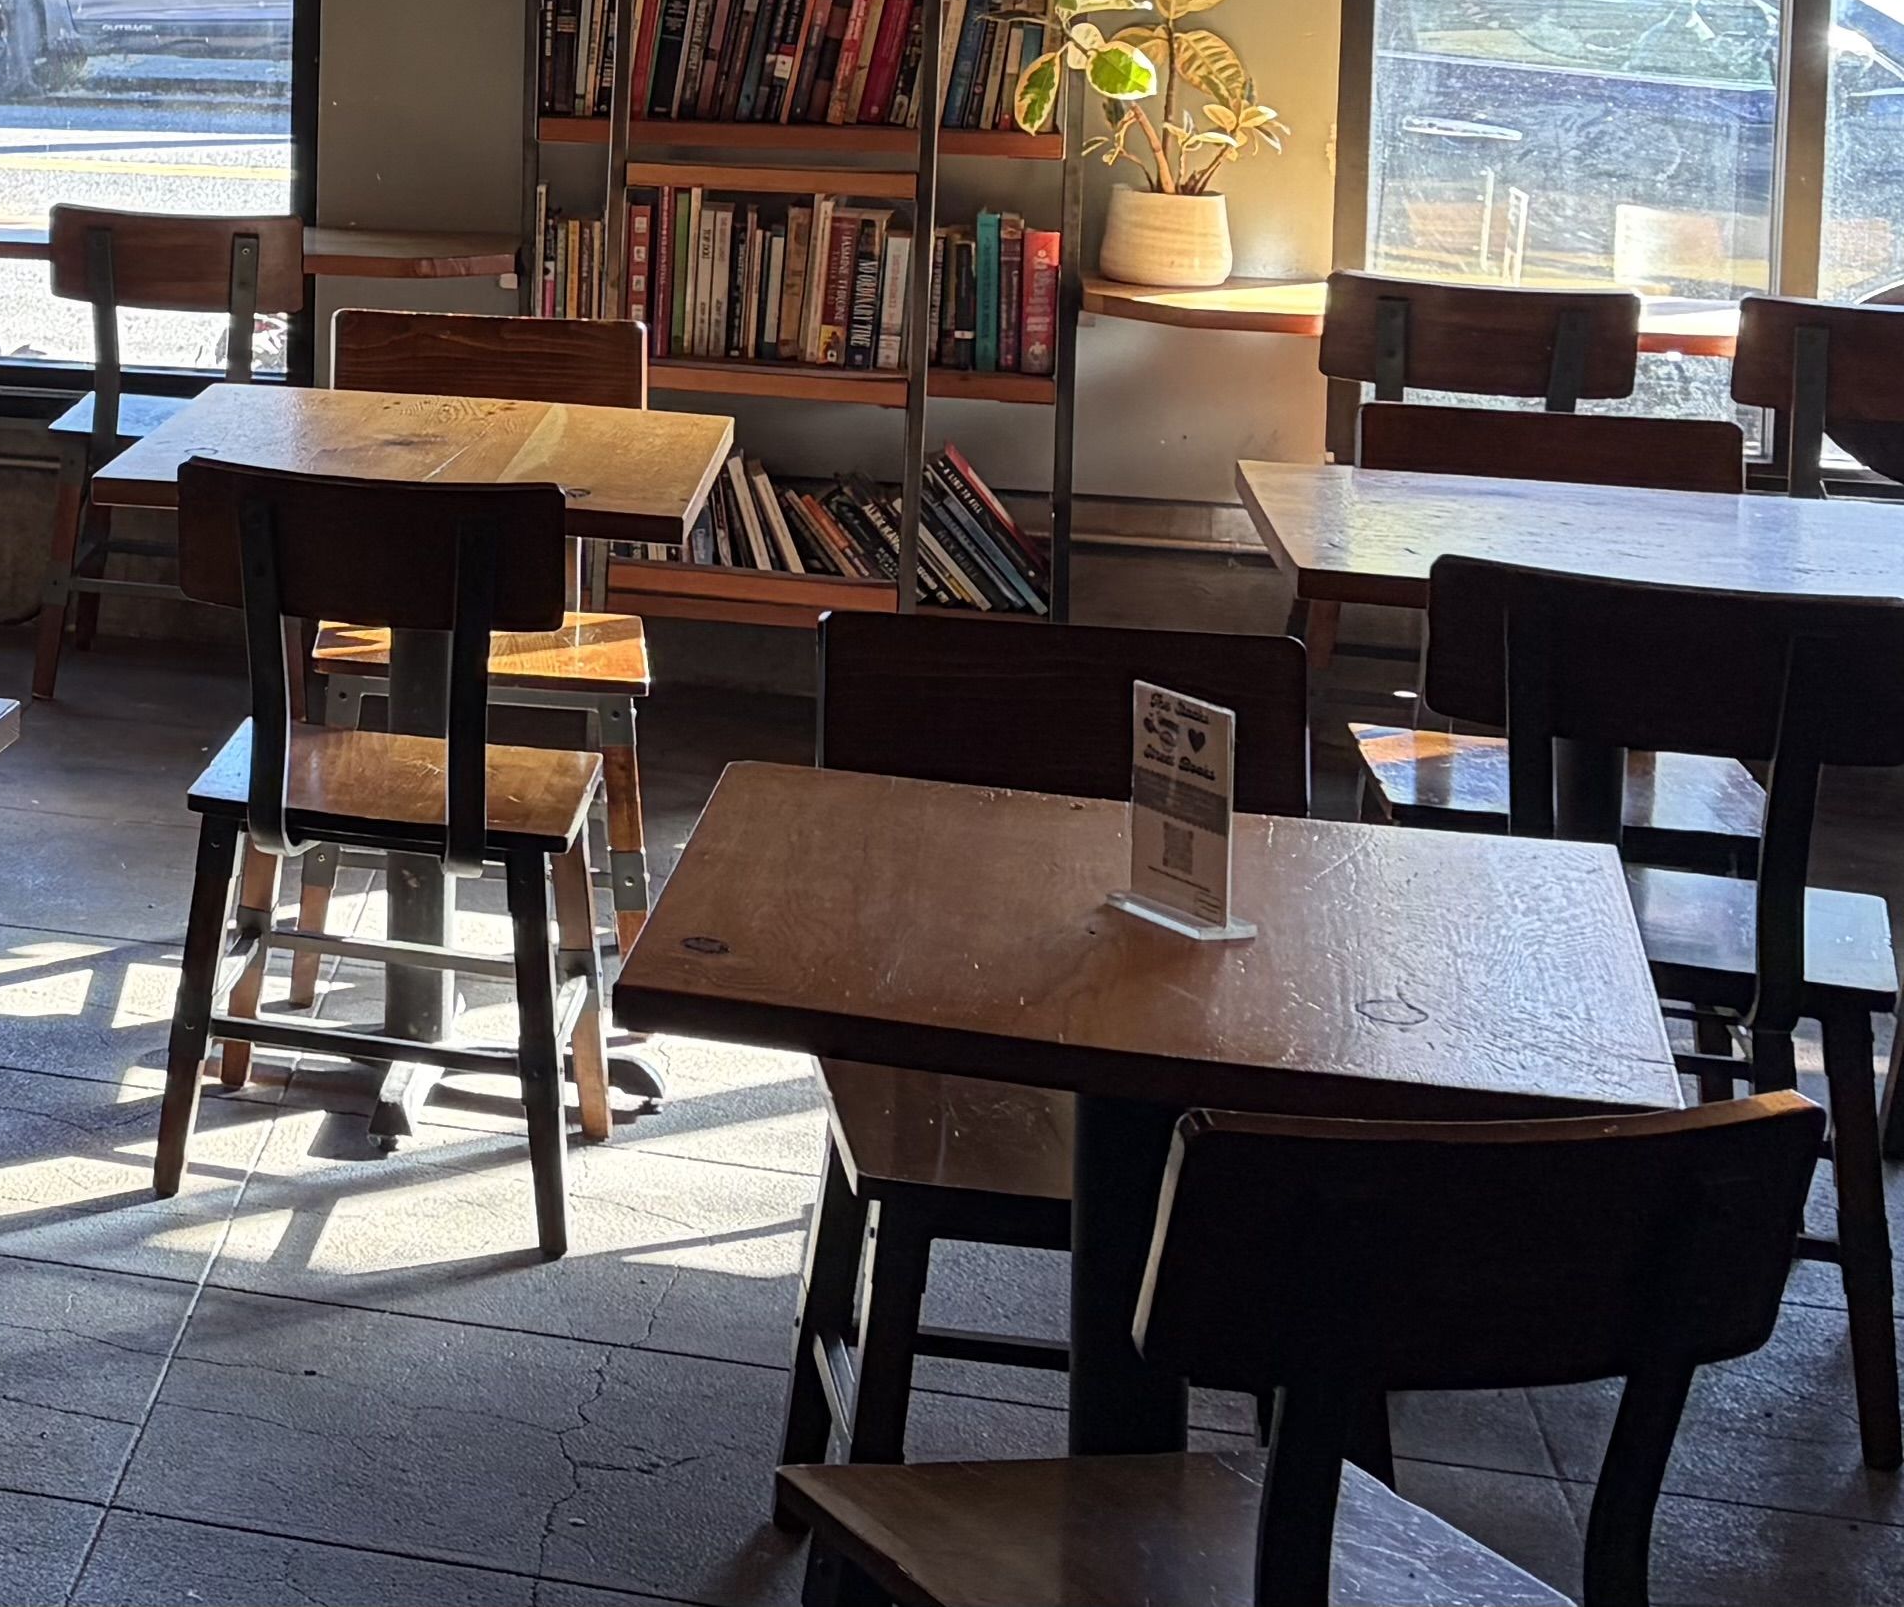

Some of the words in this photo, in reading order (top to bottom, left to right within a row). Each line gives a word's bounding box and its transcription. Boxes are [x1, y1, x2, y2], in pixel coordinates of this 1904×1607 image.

[102, 23, 153, 32] OUTBACK
[702, 228, 711, 242] TOP
[838, 235, 853, 275] JASMINE
[862, 259, 878, 273] NO
[834, 279, 850, 321] THRONE
[854, 275, 877, 322] ORDINARY
[850, 324, 870, 348] TIME
